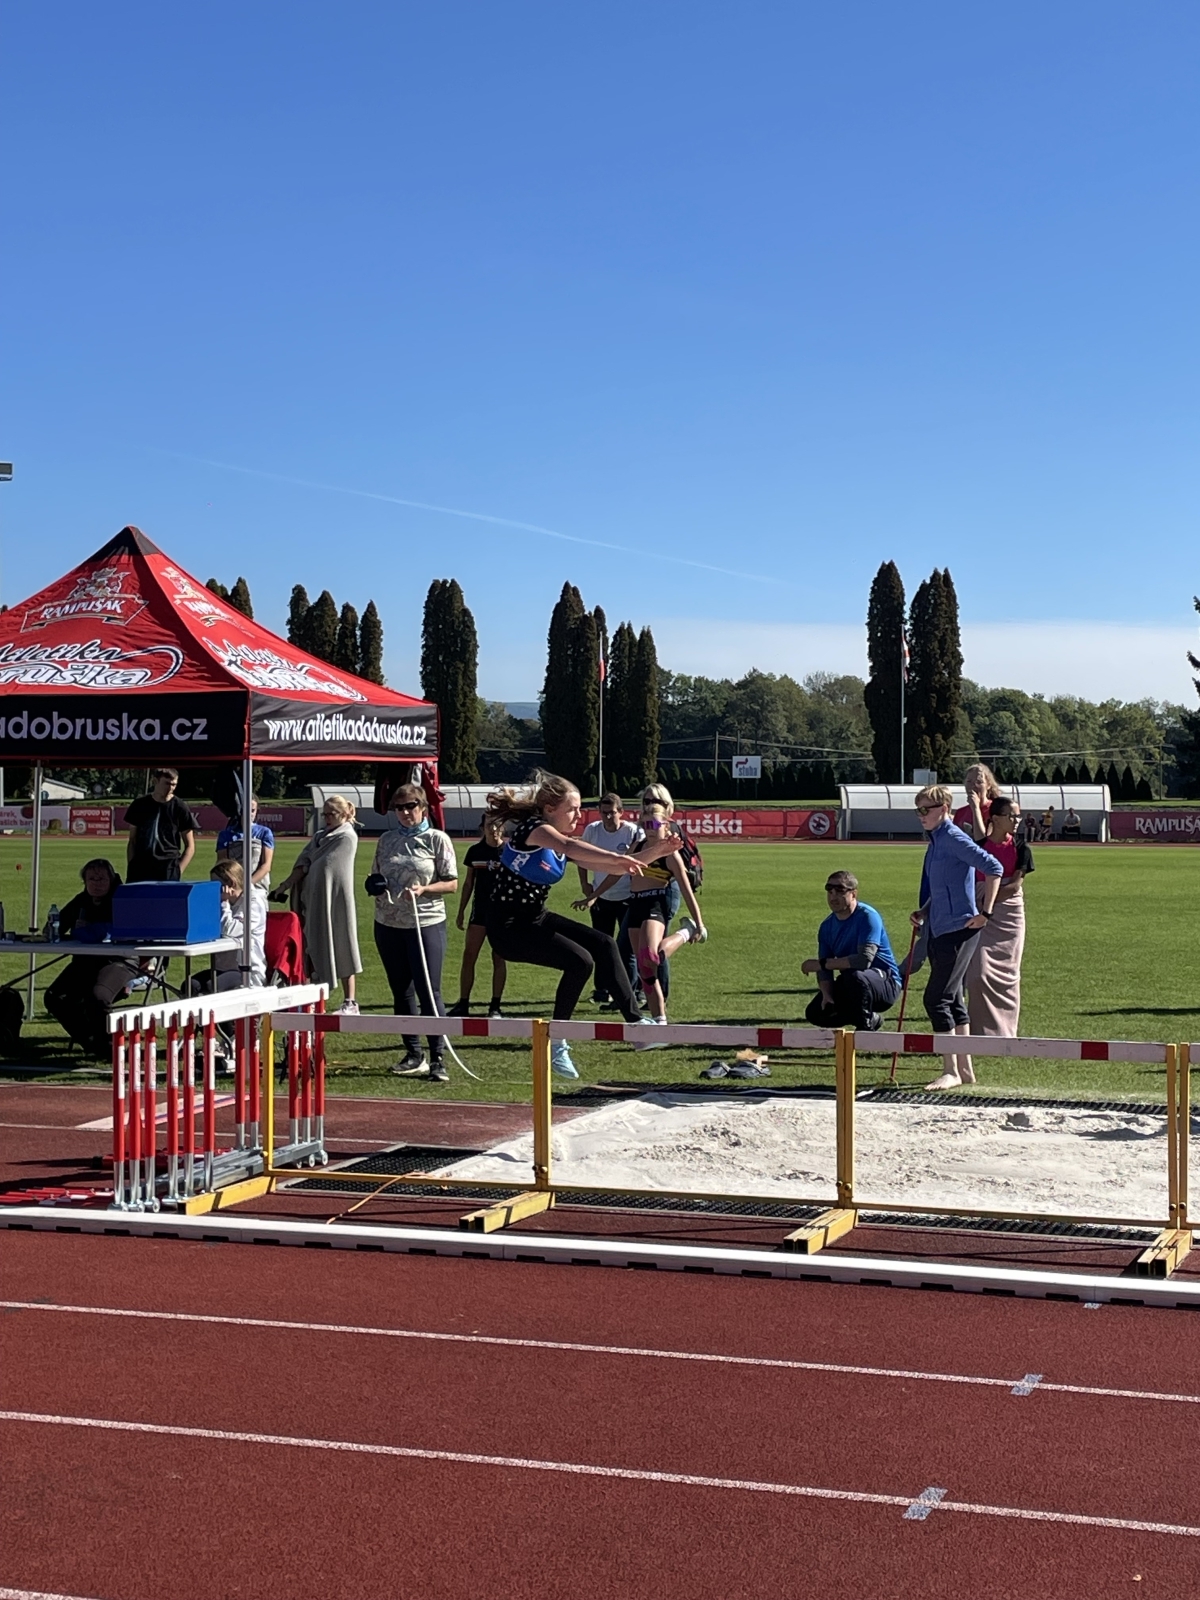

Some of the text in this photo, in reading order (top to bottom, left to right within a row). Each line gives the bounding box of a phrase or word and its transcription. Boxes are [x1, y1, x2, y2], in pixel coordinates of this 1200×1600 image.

[40, 597, 125, 619] RAMPUŠÁK
[0, 662, 152, 687] ruška
[0, 711, 208, 741] dobruska.cz
[264, 714, 427, 745] www.atletikadobruska.cz
[676, 813, 742, 834] ruška
